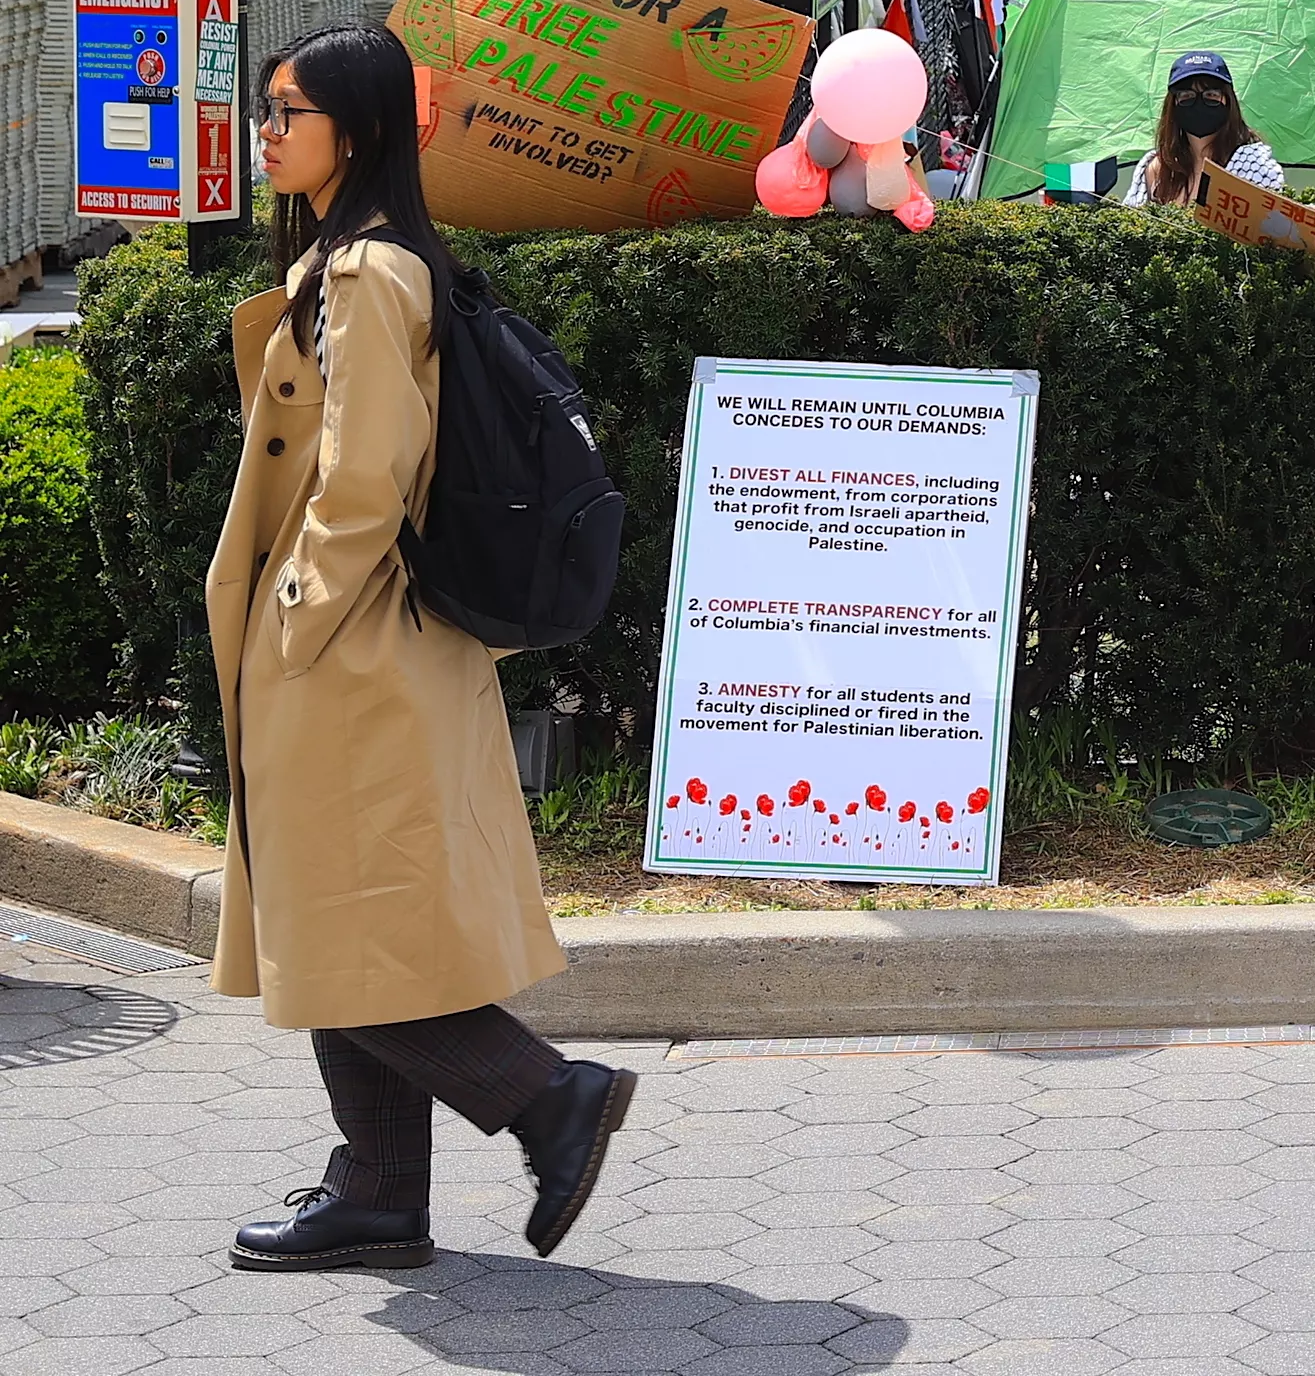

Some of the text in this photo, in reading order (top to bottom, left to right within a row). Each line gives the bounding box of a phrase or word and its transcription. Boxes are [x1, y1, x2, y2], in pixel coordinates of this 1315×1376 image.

[201, 21, 238, 43] RESIST
[683, 6, 730, 42] A
[199, 49, 236, 71] BY ANY
[130, 86, 171, 98] PUSH FOR HELP
[197, 69, 233, 92] MEANS
[196, 89, 232, 105] NECESSARY
[456, 35, 767, 162] PALESTINE
[477, 103, 634, 166] WANT TO GET
[489, 132, 614, 184] INVOLVED?
[81, 191, 172, 211] ACCESS TO SECURITY
[1217, 188, 1250, 219] BE
[717, 395, 1005, 420] WE WILL REMAIN UNTIL COLUMBIA
[732, 412, 986, 436] CONCEDES TO OUR DEMANDS:
[711, 466, 1000, 493] 1. DIVEST ALL FINANCES, including
[708, 483, 998, 507] the endowment, from corporations
[713, 499, 989, 525] that profit from Israeli apartheid,
[734, 518, 966, 539] genocide, and occupation in
[808, 536, 888, 552] Palestine.
[688, 598, 997, 623] 2. COMPLETE TRANSPARENCY for all
[690, 615, 991, 639] of Columbia's financial investments.
[698, 681, 971, 705] 3. AMNESTY for all students and
[696, 699, 970, 723] faculty disciplined or fired in the
[680, 718, 983, 740] movement for Palestinian liberation.
